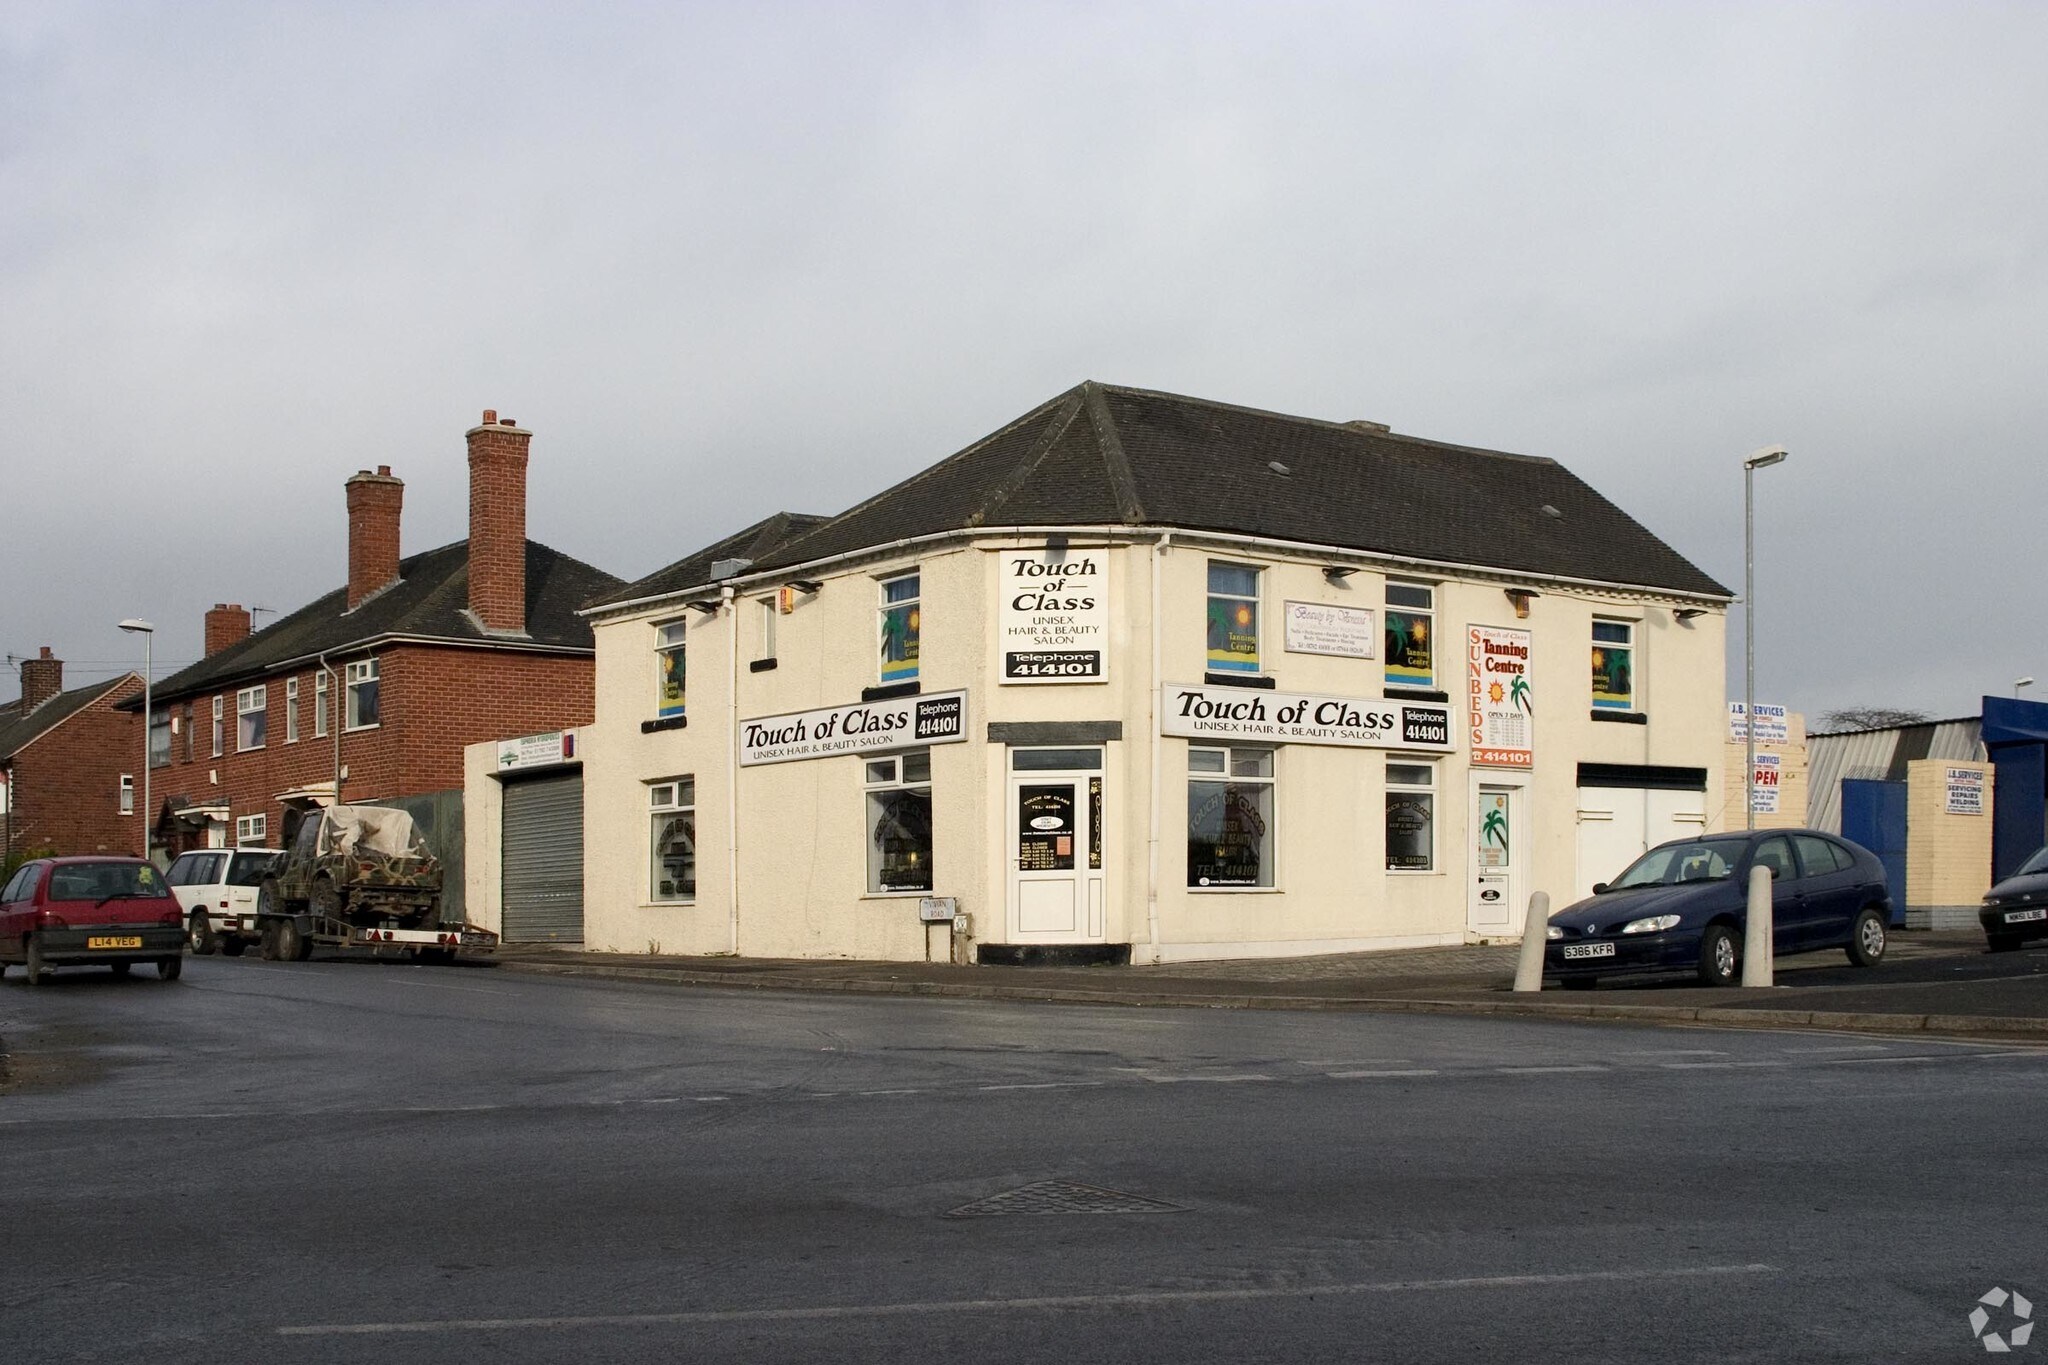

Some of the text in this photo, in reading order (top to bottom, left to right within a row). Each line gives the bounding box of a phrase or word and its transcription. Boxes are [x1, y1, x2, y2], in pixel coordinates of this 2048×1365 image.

[1011, 558, 1097, 577] Touch
[1043, 578, 1066, 592] of
[1012, 594, 1095, 611] Class
[1033, 616, 1075, 625] UNISEX
[1008, 626, 1099, 635] HAIR & BEAUTY
[1034, 636, 1074, 645] SALON
[1228, 632, 1256, 643] Tanning
[1231, 642, 1255, 652] Centre
[1483, 639, 1528, 660] Tanning
[1012, 653, 1094, 662] Telephone
[1012, 663, 1093, 675] 414101
[1486, 657, 1524, 674] Centre
[1469, 629, 1483, 744] SUNBEDS
[918, 702, 959, 716] Telephone
[1177, 691, 1395, 730] Touch of Class
[1752, 705, 1784, 717] ERVICES
[1405, 710, 1445, 723] Telephone
[745, 708, 909, 748] Touch of Class
[918, 716, 957, 735] 414101
[1194, 721, 1381, 740] UNISEX HAIR & BEAUTY SALON
[1406, 724, 1445, 741] 414101
[753, 735, 893, 759] UNISEX HAIR & BEAUTY SALON
[1484, 752, 1531, 763] 414101
[1757, 755, 1780, 764] SERVICES
[1753, 770, 1779, 785] PEN
[1958, 770, 1983, 780] SERVICES
[1948, 785, 1982, 793] SERVICING
[1951, 791, 1978, 799] REPAIRS
[1024, 796, 1041, 805] TOUCH
[1053, 796, 1070, 805] CLASS
[1190, 792, 1265, 837] TOUCH OF CLASS
[1226, 864, 1258, 876] 414101
[115, 937, 136, 946] VEG
[1565, 944, 1613, 957] S386 KFR
